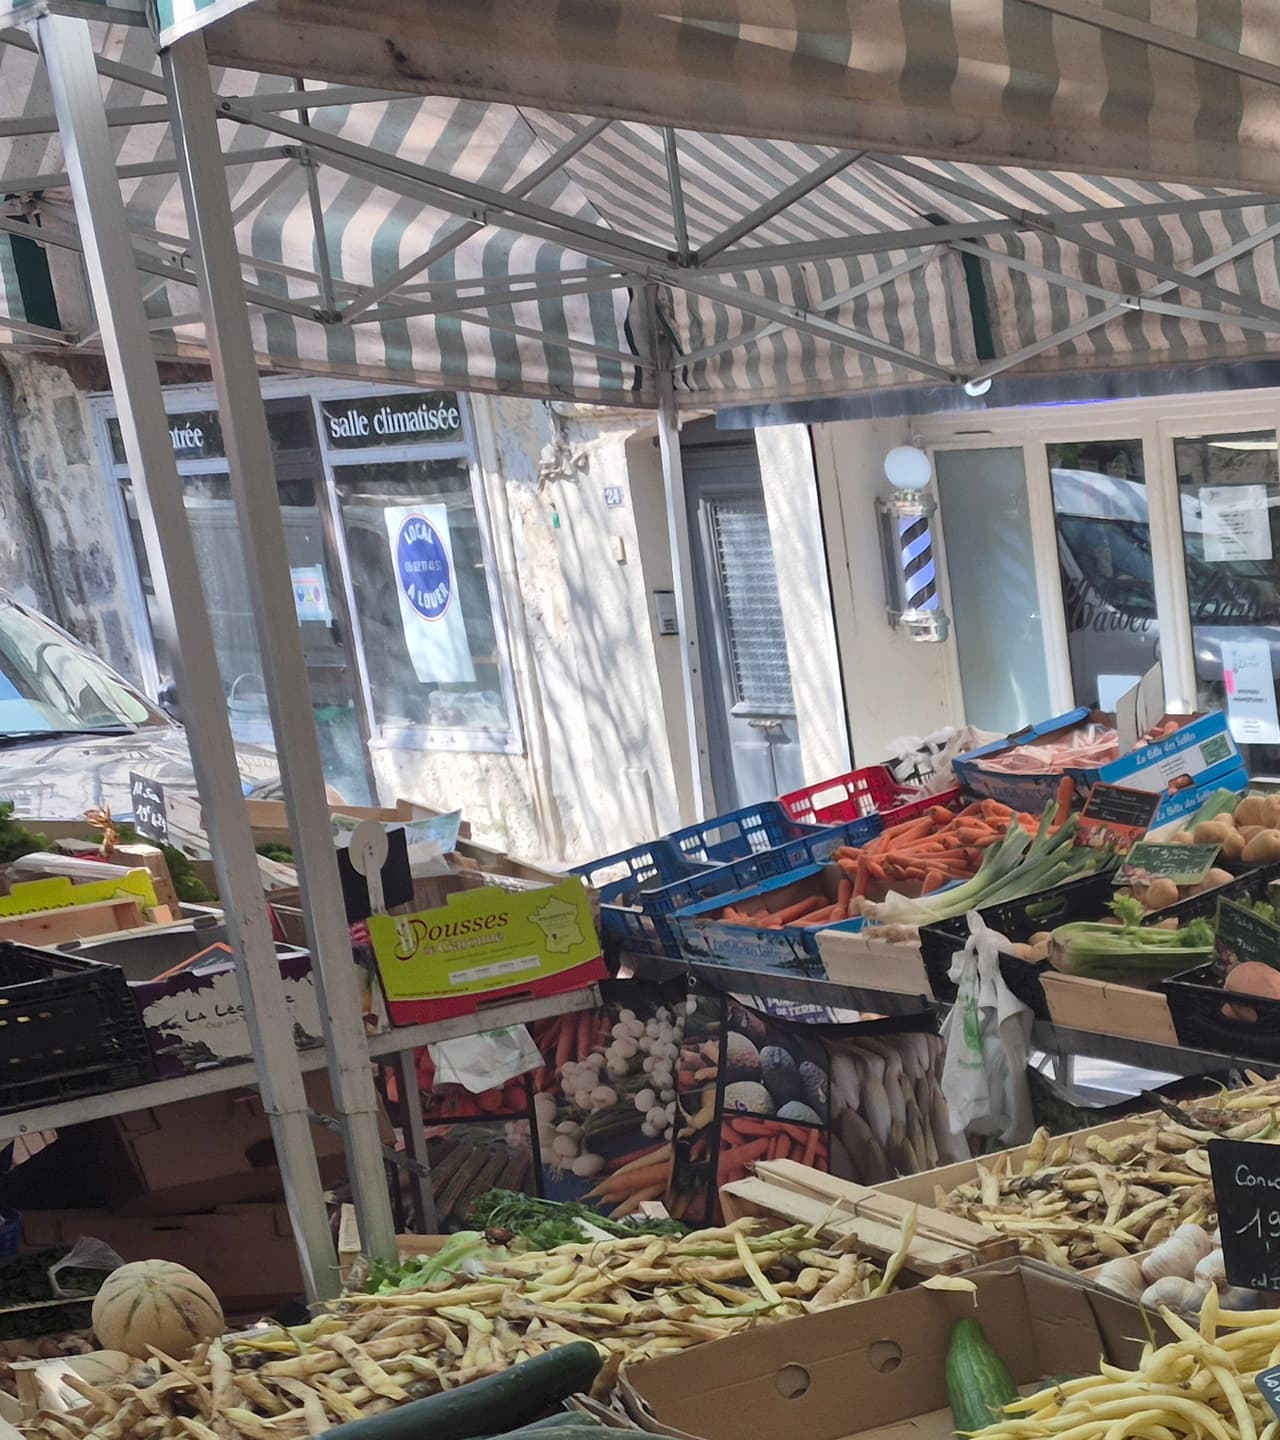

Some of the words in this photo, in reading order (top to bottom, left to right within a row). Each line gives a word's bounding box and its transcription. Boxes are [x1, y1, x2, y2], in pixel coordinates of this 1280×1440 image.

[330, 412, 370, 438] salle
[374, 402, 461, 434] climatisée
[604, 487, 622, 504] 24
[403, 523, 434, 545] LOCAL
[407, 584, 416, 601] A
[417, 582, 449, 609] LOUER
[393, 911, 510, 961] Pousses
